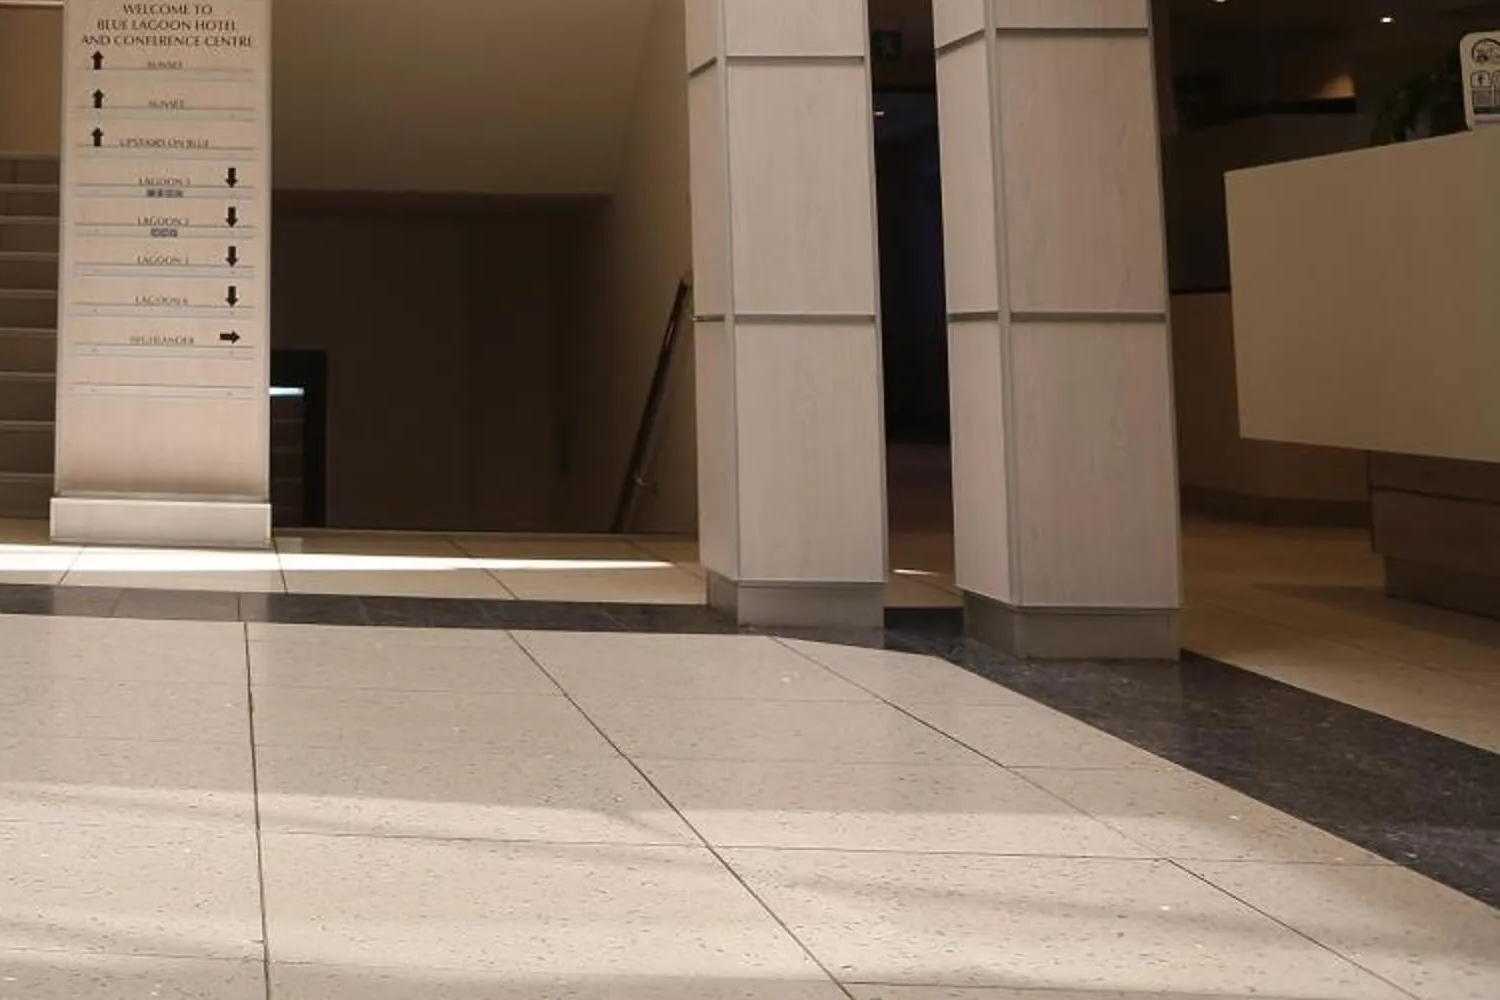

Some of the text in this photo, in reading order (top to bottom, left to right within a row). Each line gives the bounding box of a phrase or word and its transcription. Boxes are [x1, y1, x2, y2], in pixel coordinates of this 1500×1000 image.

[123, 3, 213, 15] WELCOME TO
[97, 19, 237, 31] BLUE LAGOON HOTEL
[82, 36, 252, 48] AND CONFERENCE CENTRE
